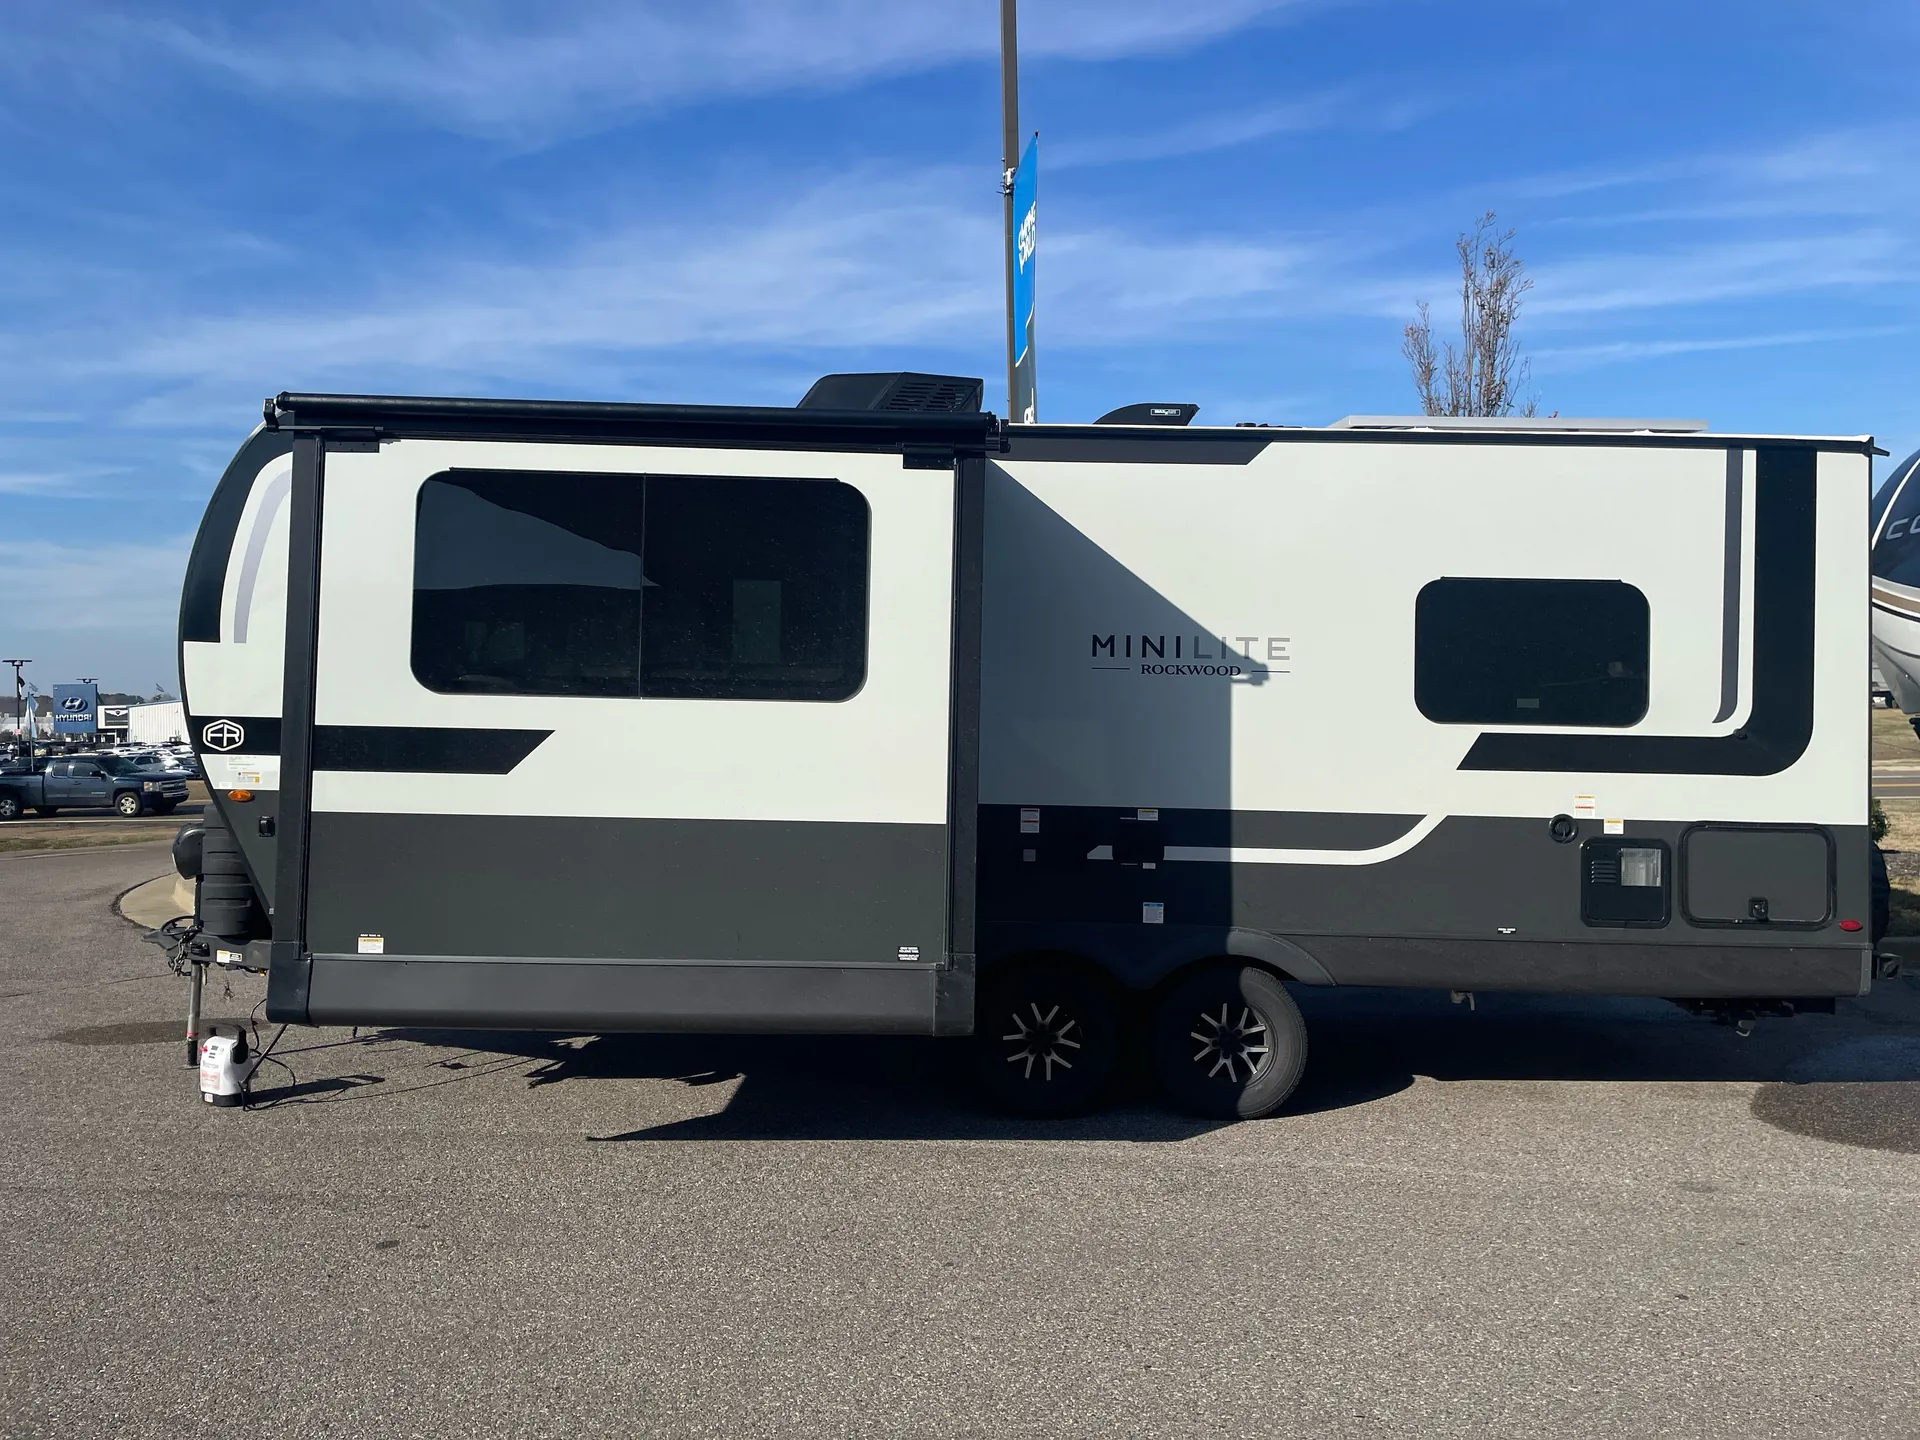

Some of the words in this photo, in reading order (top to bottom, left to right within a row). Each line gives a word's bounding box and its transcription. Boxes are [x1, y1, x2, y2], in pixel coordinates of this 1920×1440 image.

[1091, 634, 1291, 661] MINILITE
[1140, 663, 1242, 677] ROCKWOOD
[55, 713, 92, 722] HYUNDAI
